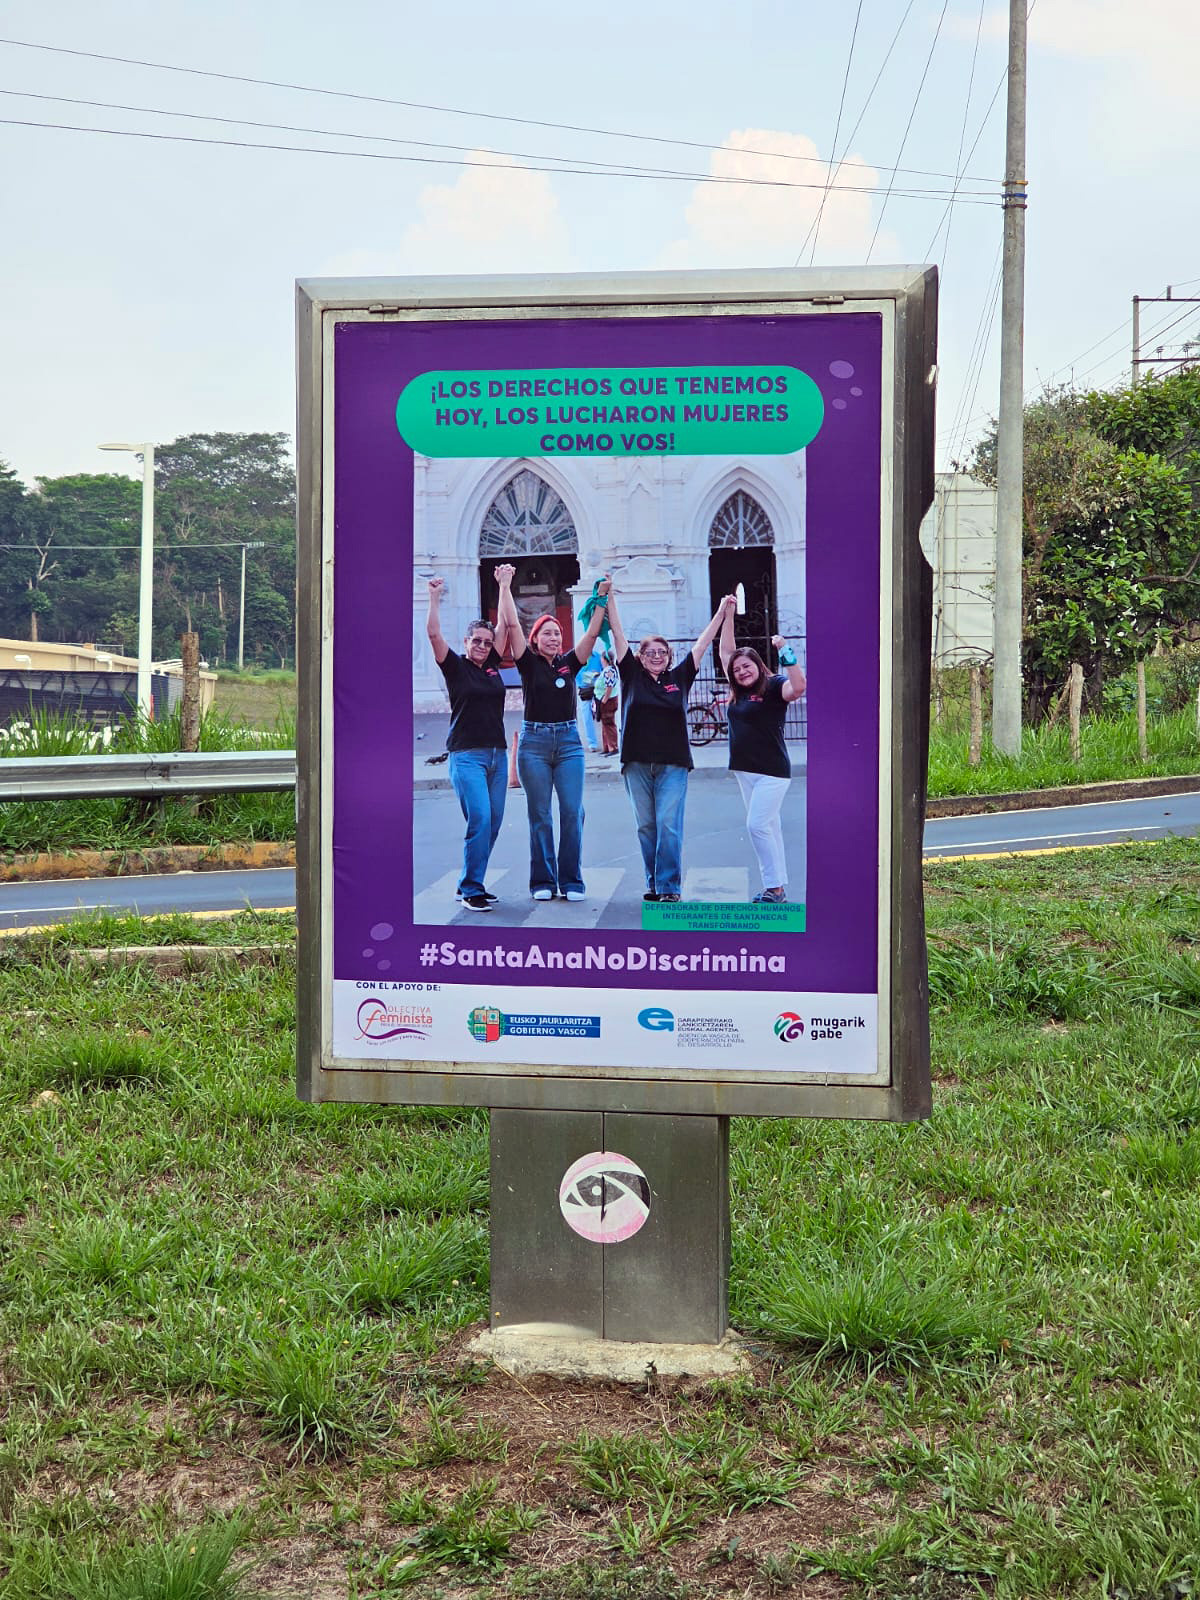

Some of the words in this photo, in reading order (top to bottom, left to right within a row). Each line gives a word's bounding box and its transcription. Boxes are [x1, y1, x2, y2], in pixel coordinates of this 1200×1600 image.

[431, 381, 481, 404] ¡LOS
[488, 378, 612, 398] DERECHOS
[618, 378, 668, 396] QUE
[675, 376, 788, 395] TENEMOS
[435, 408, 489, 428] HOY,
[495, 407, 539, 425] LOS
[546, 405, 676, 424] LUCHARON
[684, 404, 789, 423] MUJERES
[540, 434, 614, 451] COMO
[620, 433, 676, 451] VOS!
[419, 942, 786, 973] #SantaAnaNoDiscrimina
[510, 1016, 536, 1024] EUSKO
[539, 1017, 592, 1025] JAURLARITZA
[811, 1016, 865, 1029] mugarik
[811, 1028, 842, 1040] gabe
